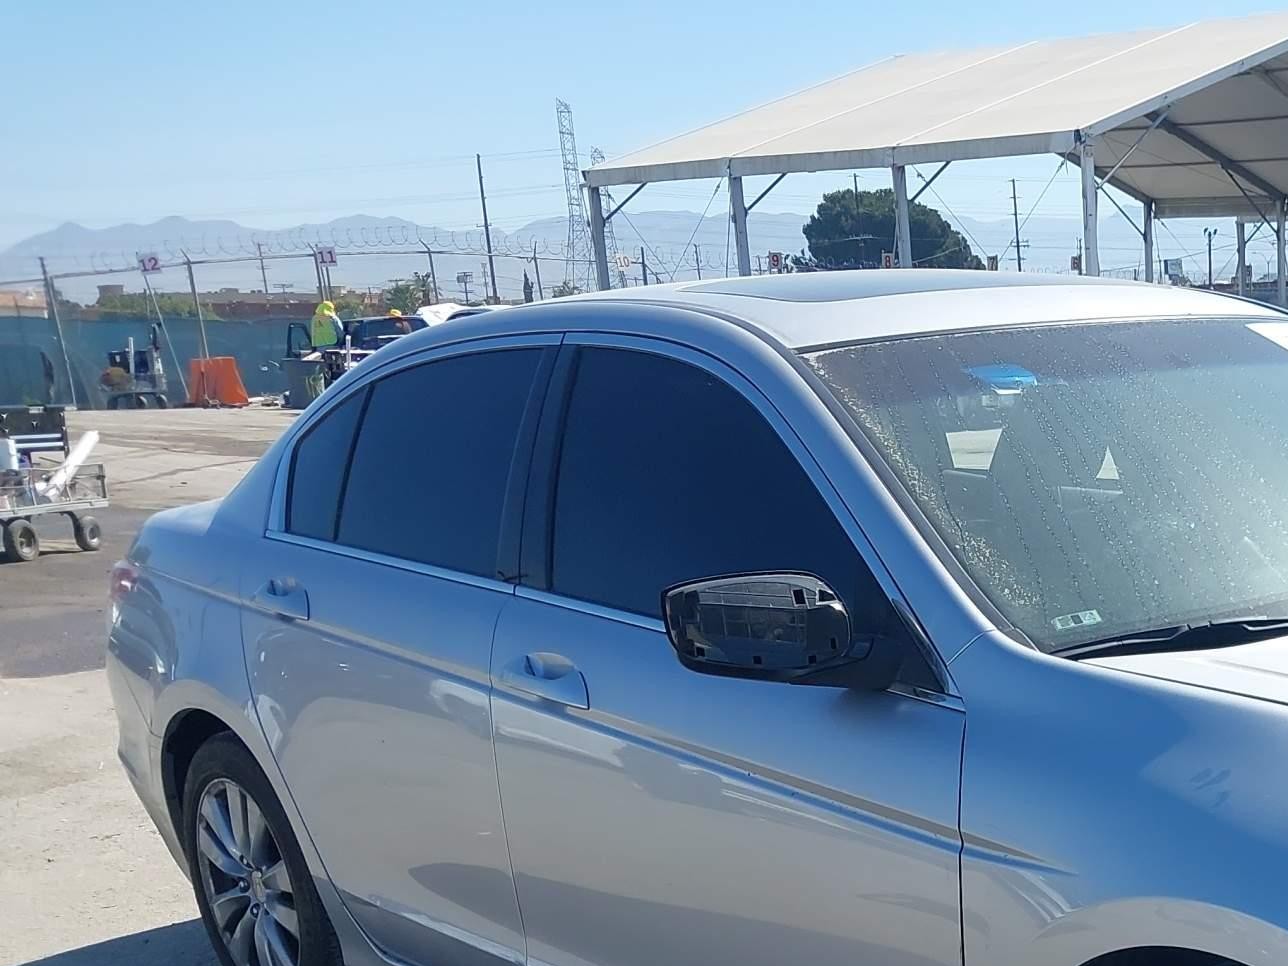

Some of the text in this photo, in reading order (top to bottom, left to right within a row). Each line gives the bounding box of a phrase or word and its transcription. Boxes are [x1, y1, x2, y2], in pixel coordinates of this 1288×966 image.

[317, 250, 336, 264] 11
[616, 255, 630, 268] 10
[771, 254, 779, 267] 9
[138, 257, 160, 272] 12
